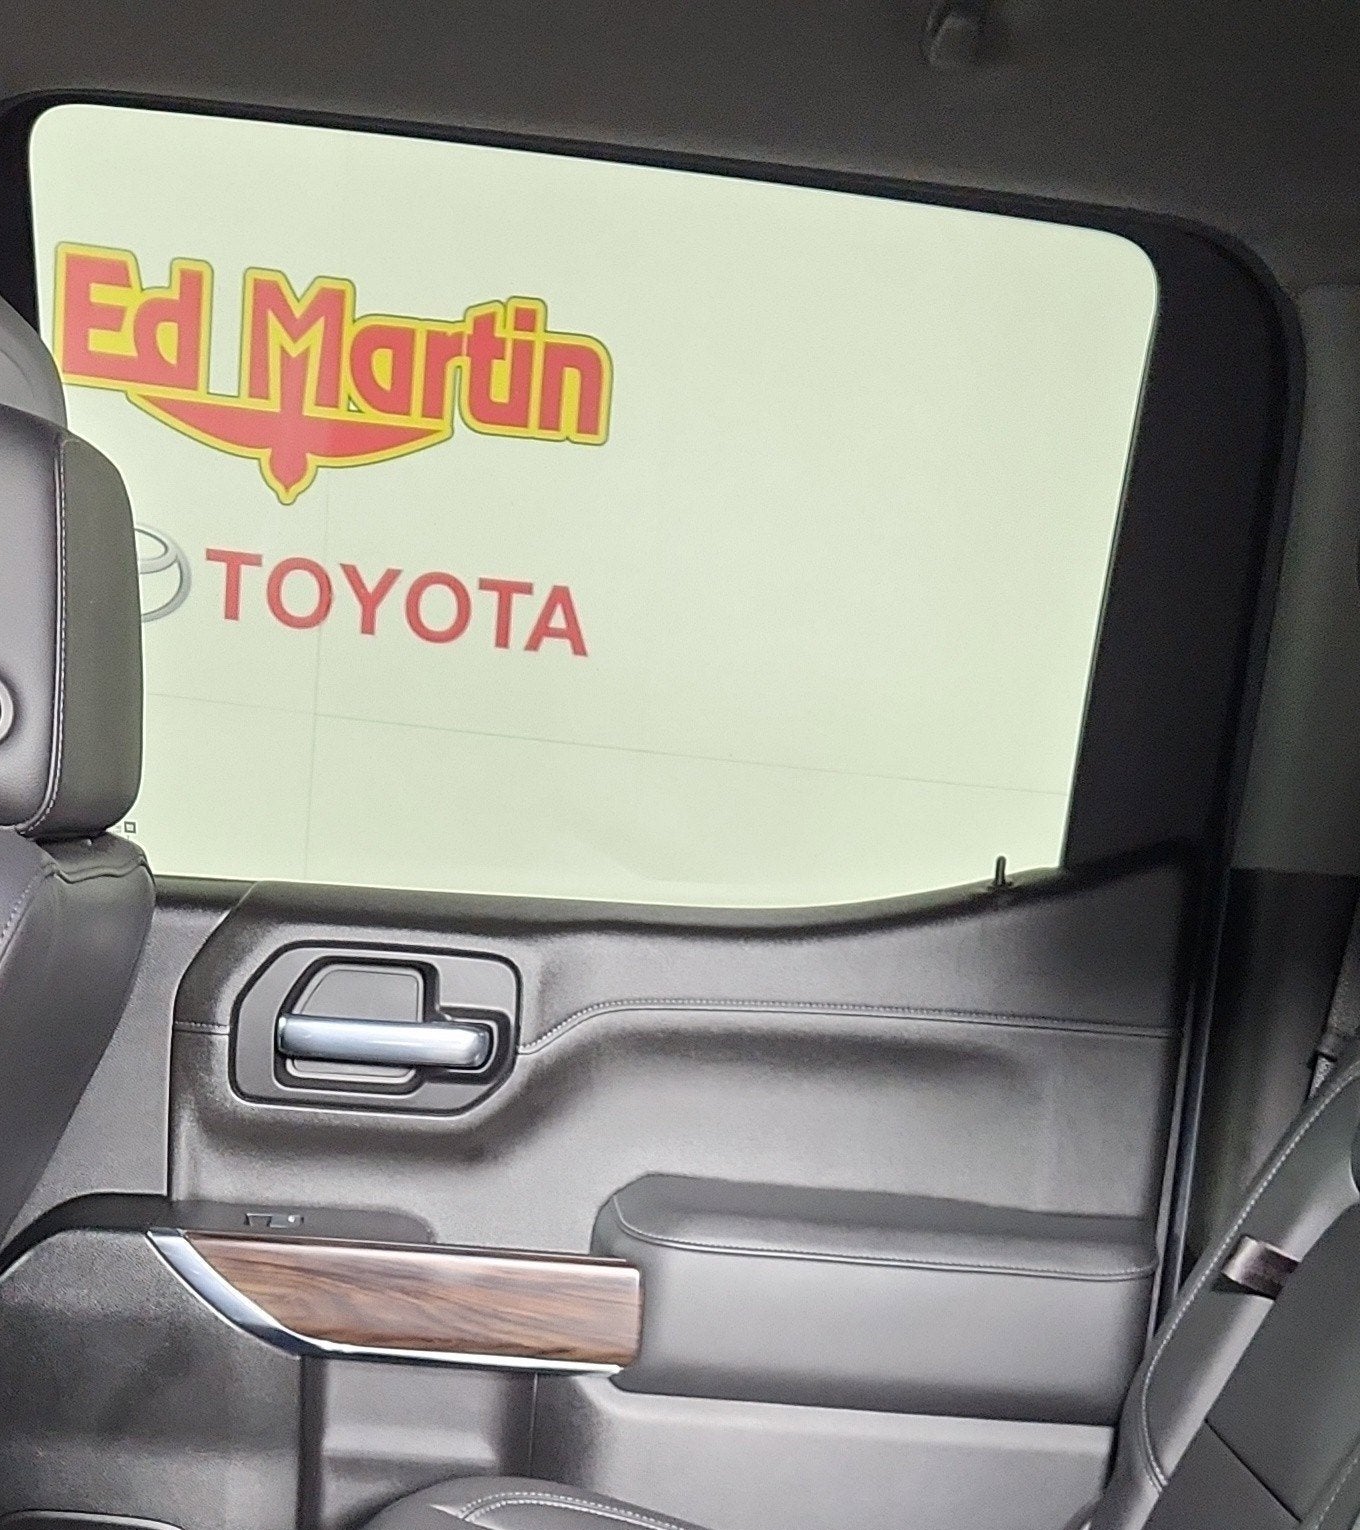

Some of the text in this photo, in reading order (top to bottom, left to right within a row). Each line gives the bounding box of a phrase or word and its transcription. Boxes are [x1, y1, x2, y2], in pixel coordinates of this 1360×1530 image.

[59, 250, 607, 440] Ed Martin
[205, 548, 589, 657] TOYOTA
